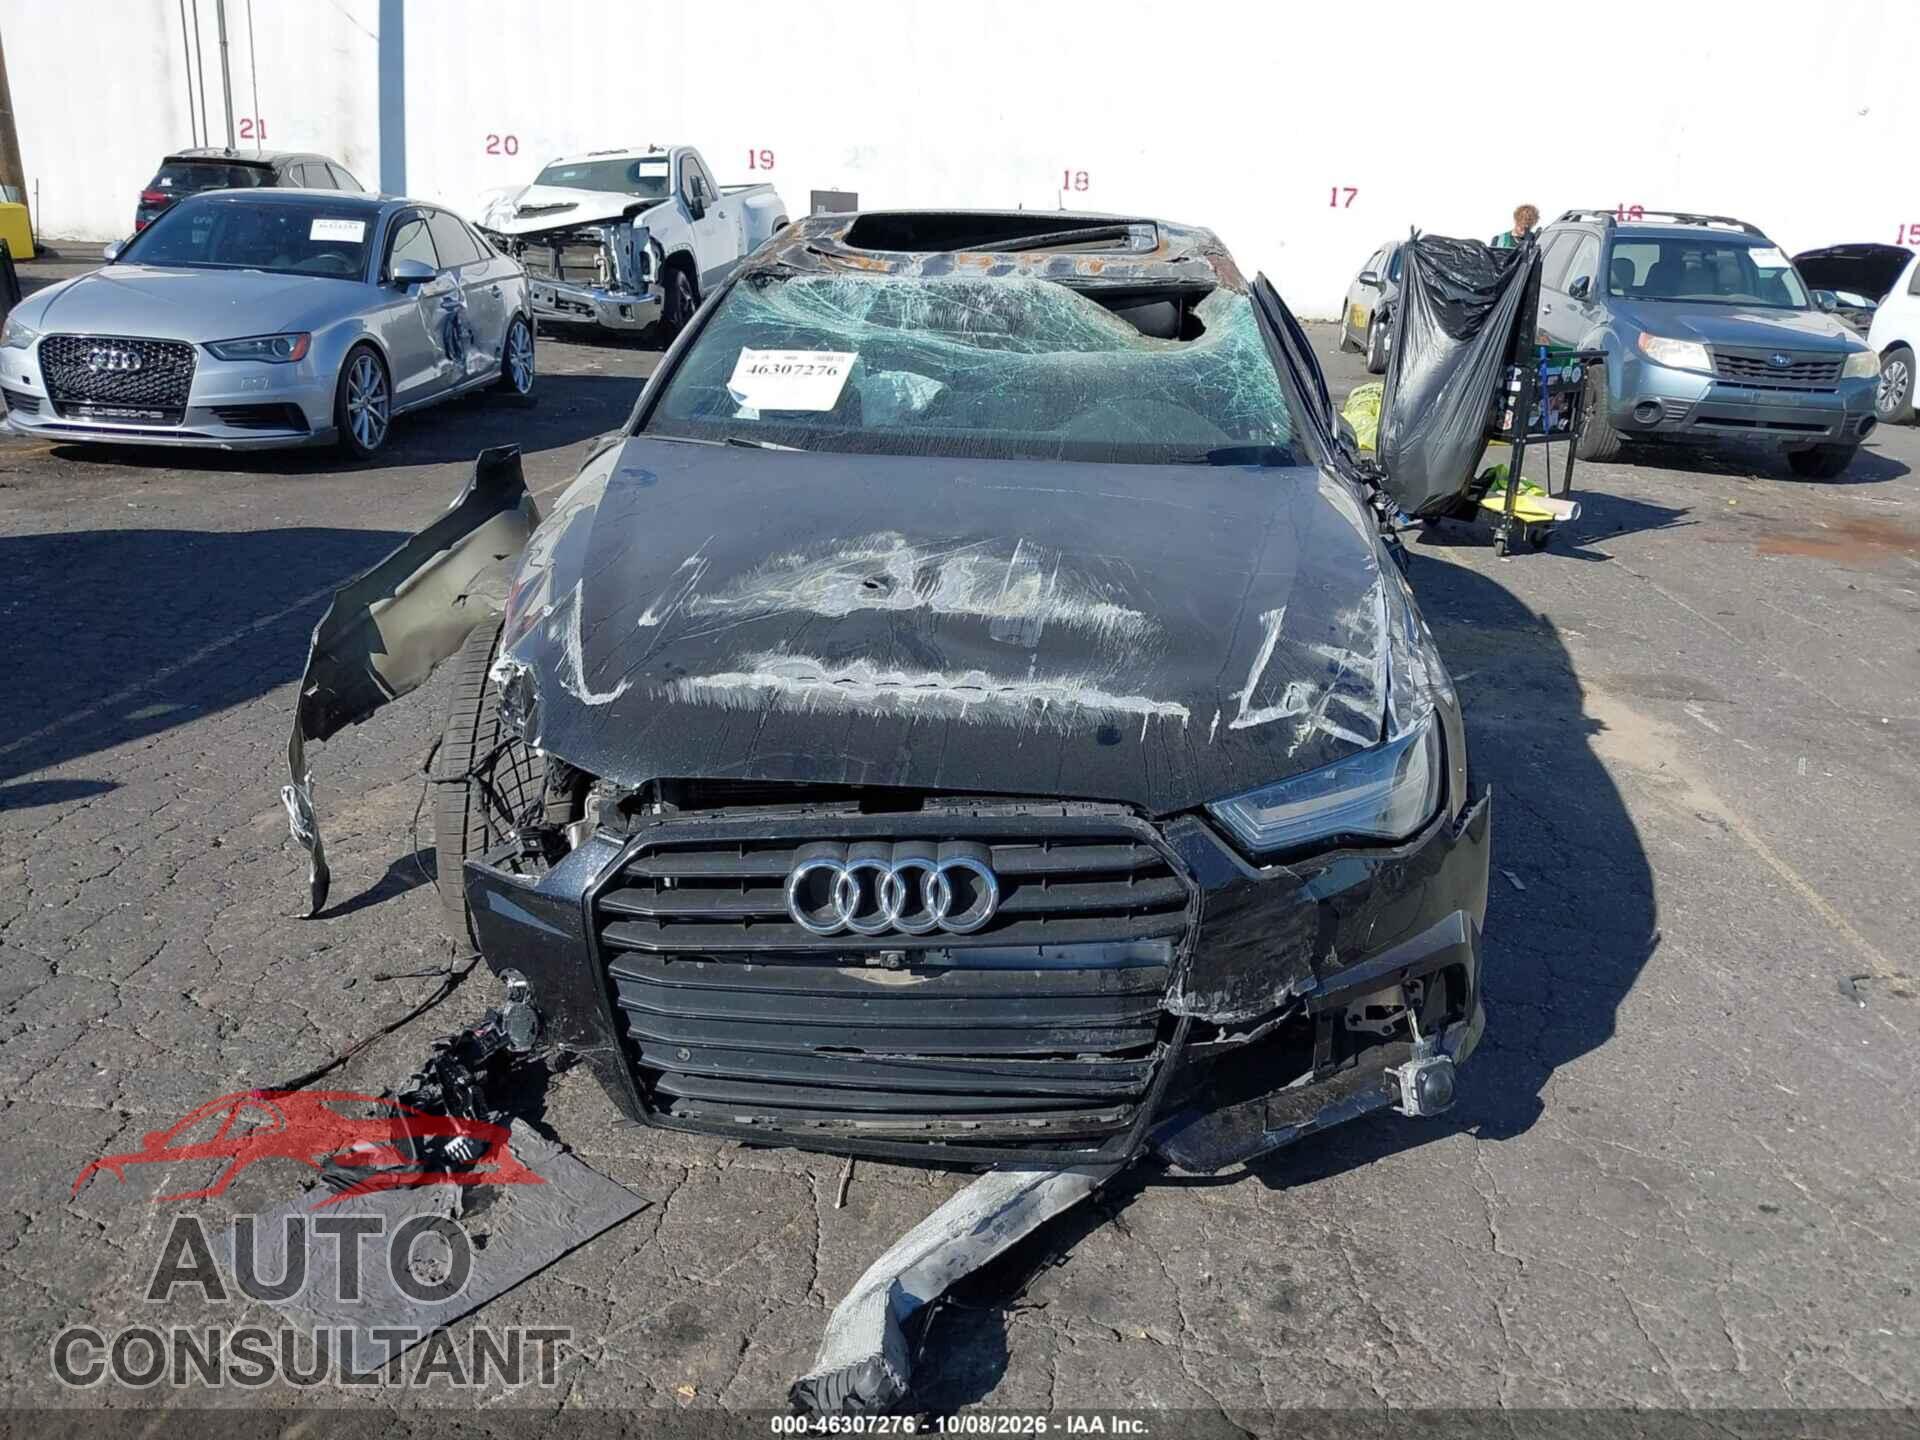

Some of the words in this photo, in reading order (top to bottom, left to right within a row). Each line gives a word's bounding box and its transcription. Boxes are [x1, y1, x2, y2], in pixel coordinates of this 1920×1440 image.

[239, 118, 267, 139] 21
[486, 134, 519, 156] 20
[748, 149, 774, 170] 19
[1063, 170, 1089, 191] 18
[1329, 187, 1358, 208] 17
[1895, 223, 1920, 246] 15
[746, 363, 839, 377] 46307276
